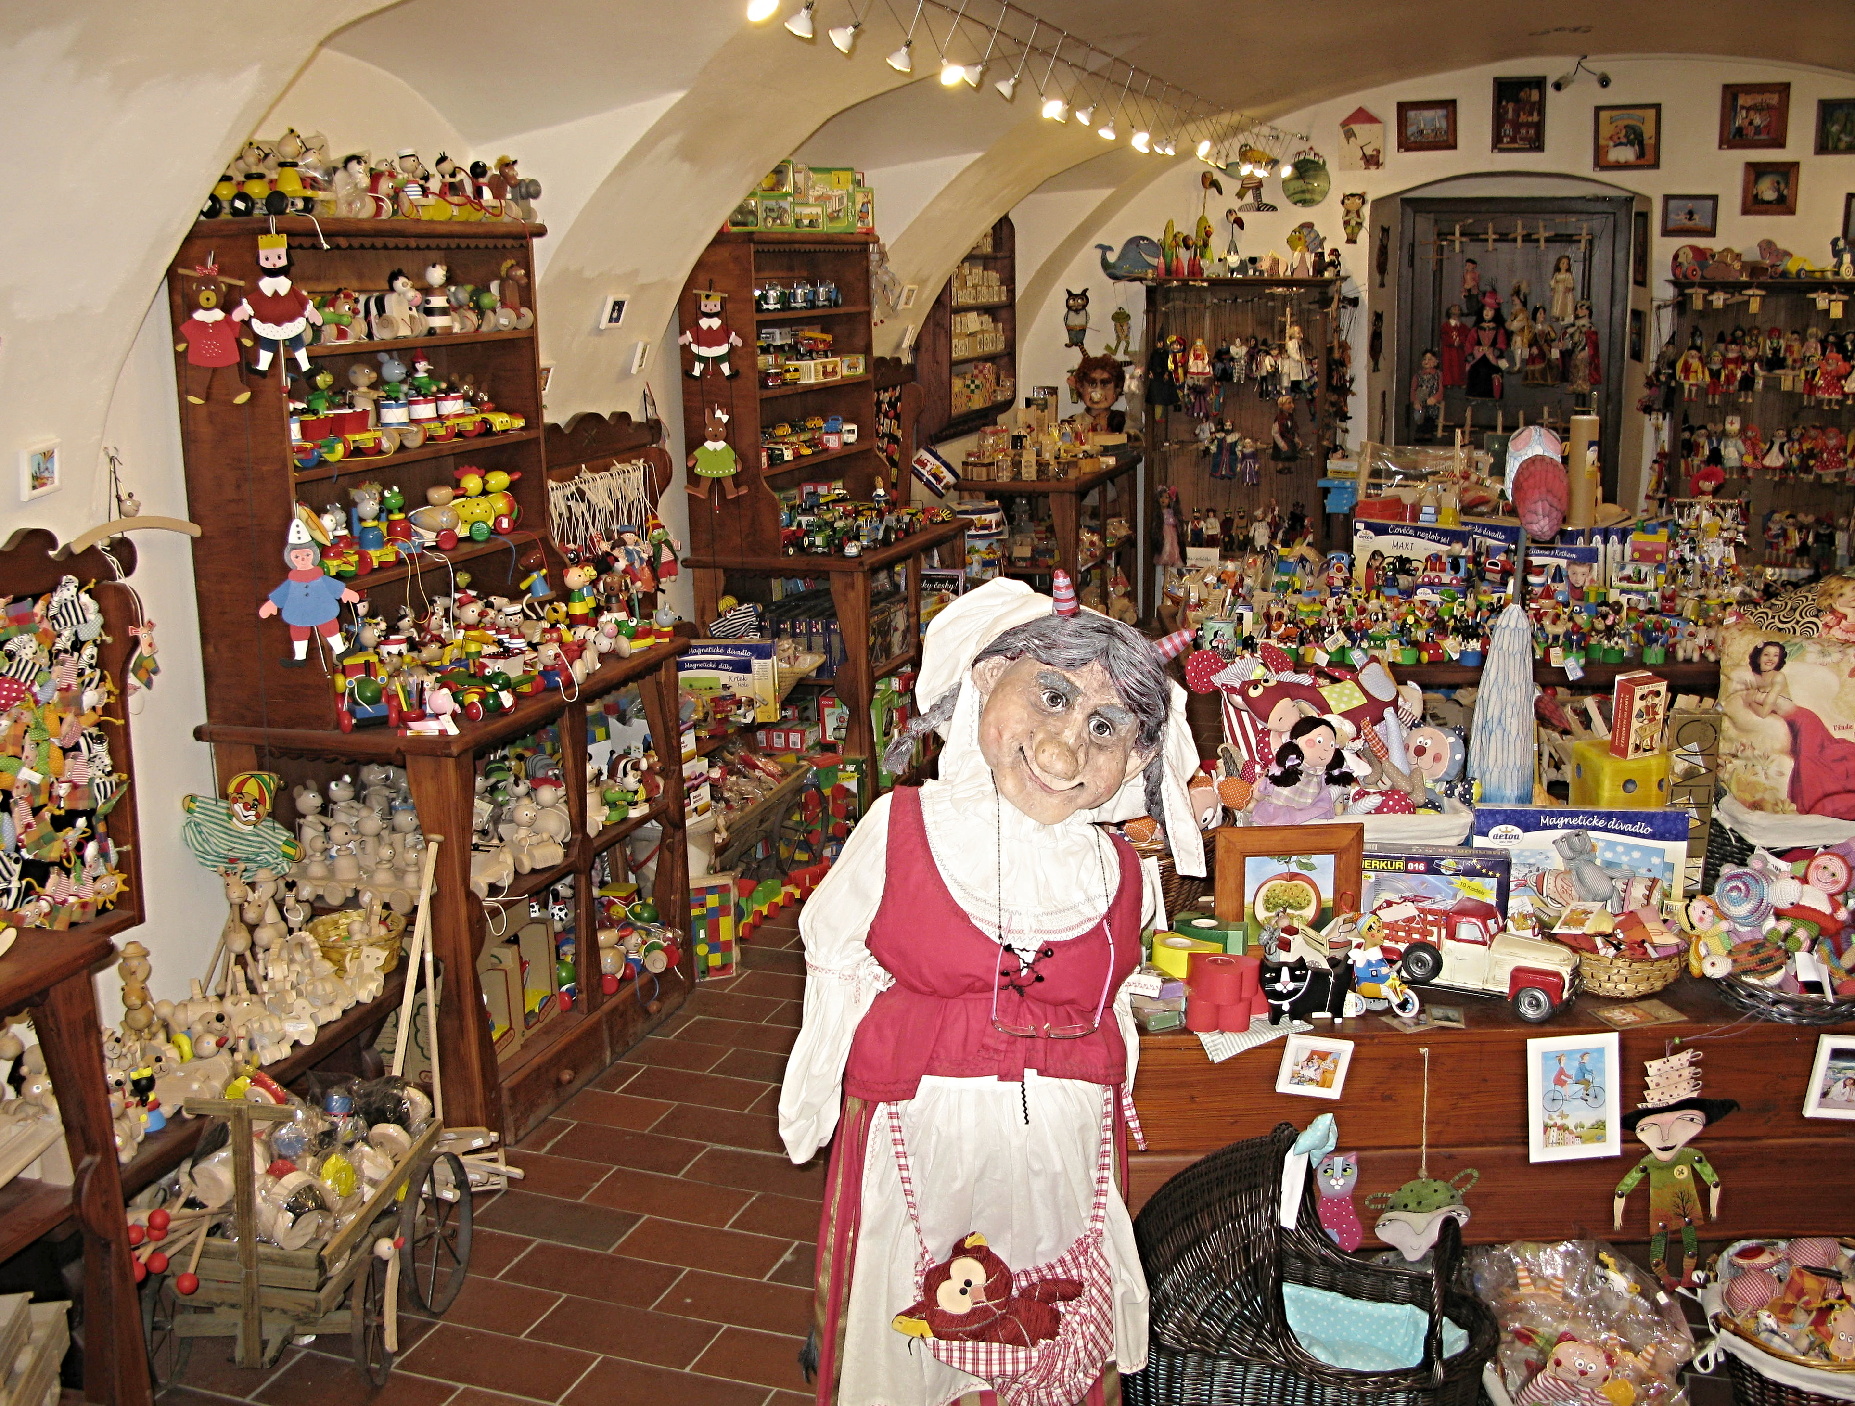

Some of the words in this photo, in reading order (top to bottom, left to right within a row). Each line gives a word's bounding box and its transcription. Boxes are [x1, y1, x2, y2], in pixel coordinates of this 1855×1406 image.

[1391, 540, 1415, 551] MAXI
[727, 647, 753, 657] divadlo
[1540, 815, 1607, 829] Magnetické
[1607, 818, 1653, 835] divadlo
[1362, 860, 1405, 870] ERKUR
[1407, 862, 1425, 871] 016
